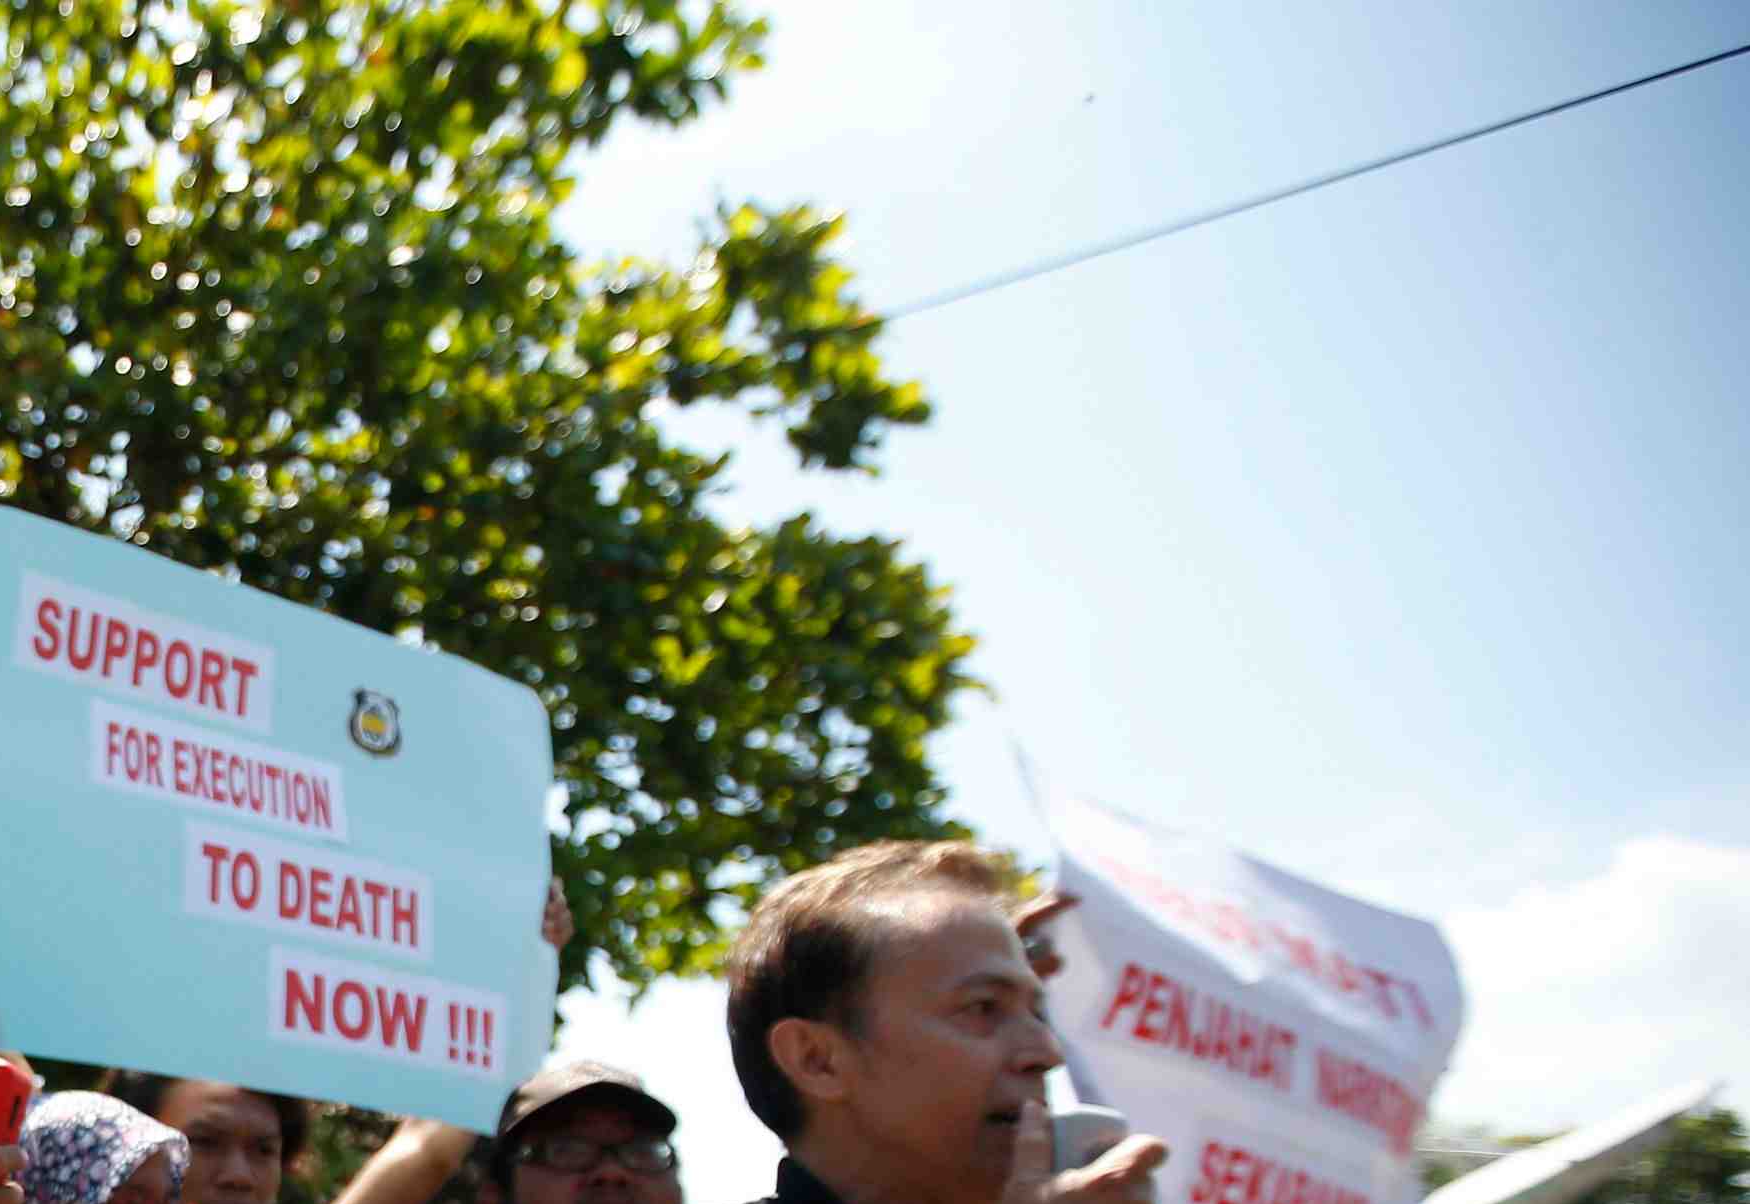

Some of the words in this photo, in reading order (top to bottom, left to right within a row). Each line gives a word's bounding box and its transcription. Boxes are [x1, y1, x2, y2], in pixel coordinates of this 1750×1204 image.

[31, 597, 260, 718] SUPPORT
[107, 721, 161, 788] FOR
[172, 739, 333, 831] EXECUTION
[201, 842, 262, 911] TO
[277, 861, 420, 949] DEATH
[283, 968, 428, 1053] NOW
[446, 1002, 495, 1068] !!!
